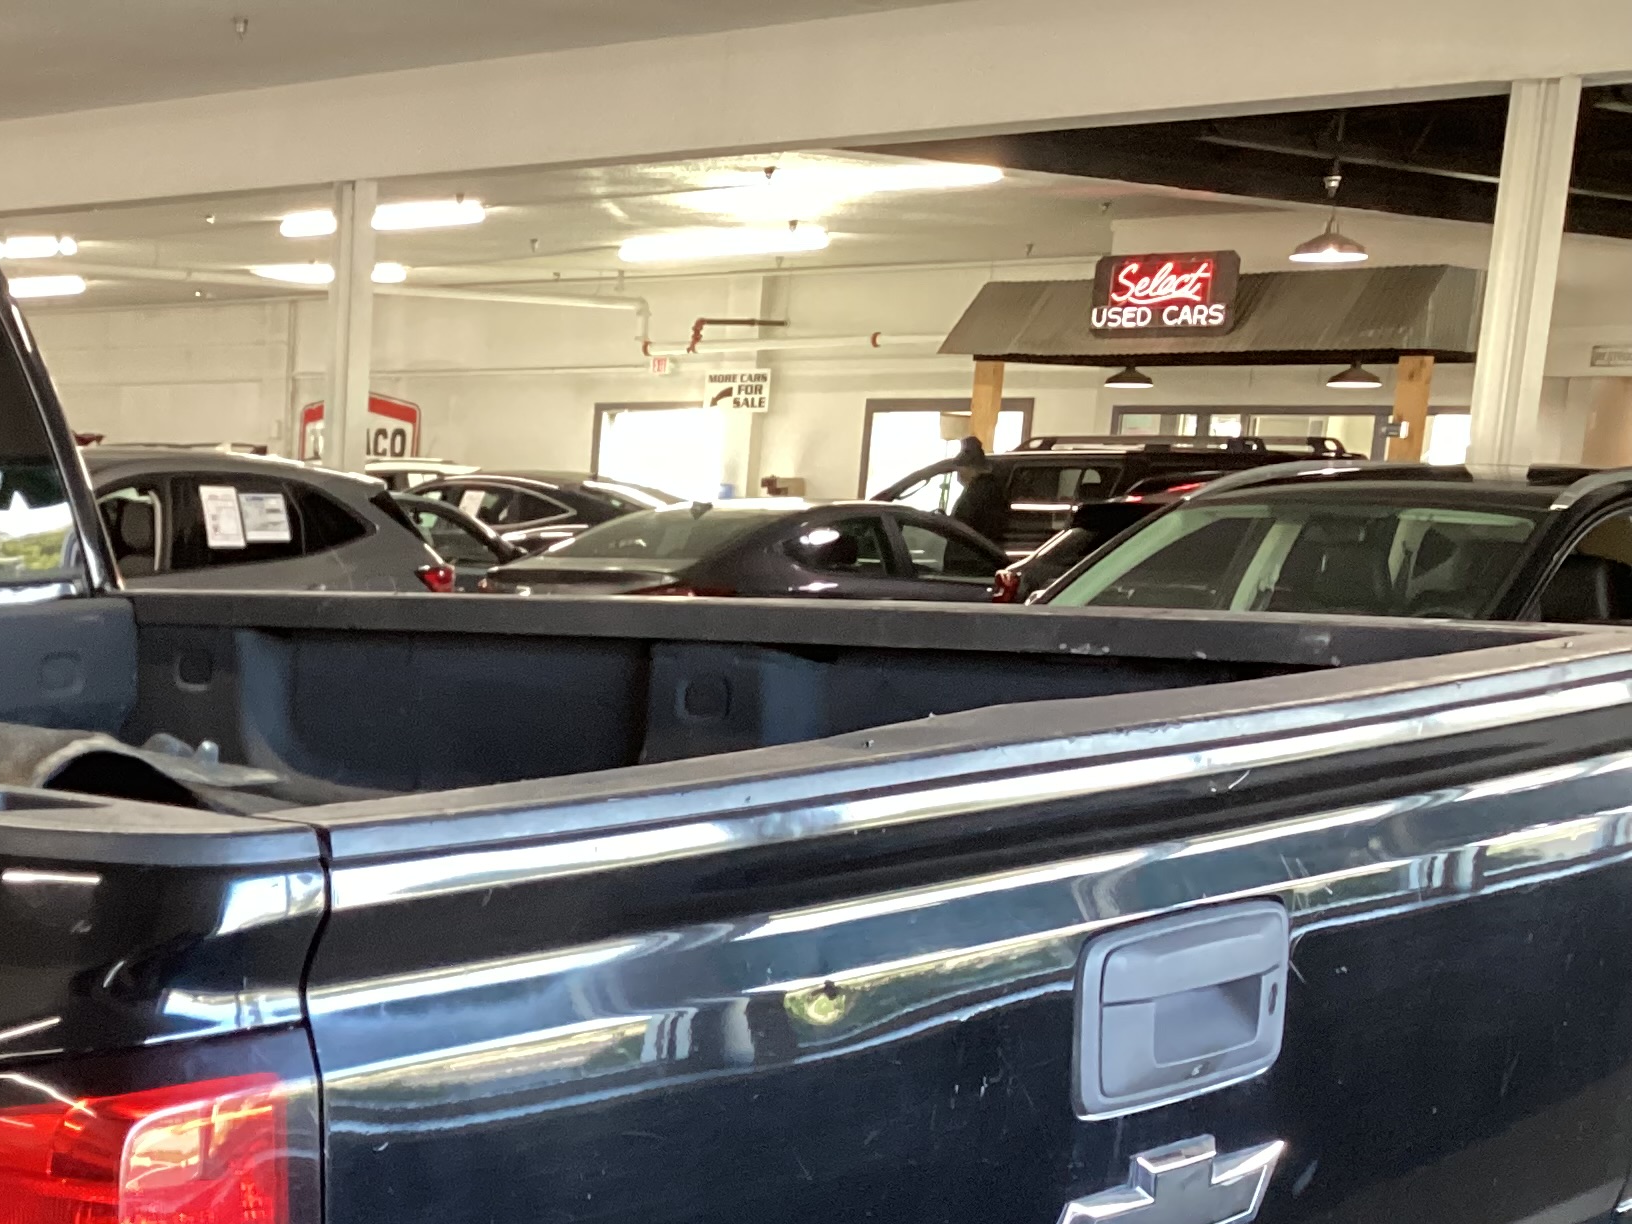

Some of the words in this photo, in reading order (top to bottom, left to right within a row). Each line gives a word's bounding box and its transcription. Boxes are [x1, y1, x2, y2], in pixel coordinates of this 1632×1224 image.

[1111, 262, 1211, 304] Select
[1091, 306, 1152, 328] USED
[1162, 304, 1225, 326] CARS
[708, 374, 738, 383] MORE
[740, 373, 768, 383] CARS
[736, 384, 763, 395] FOR
[732, 397, 766, 408] SALE
